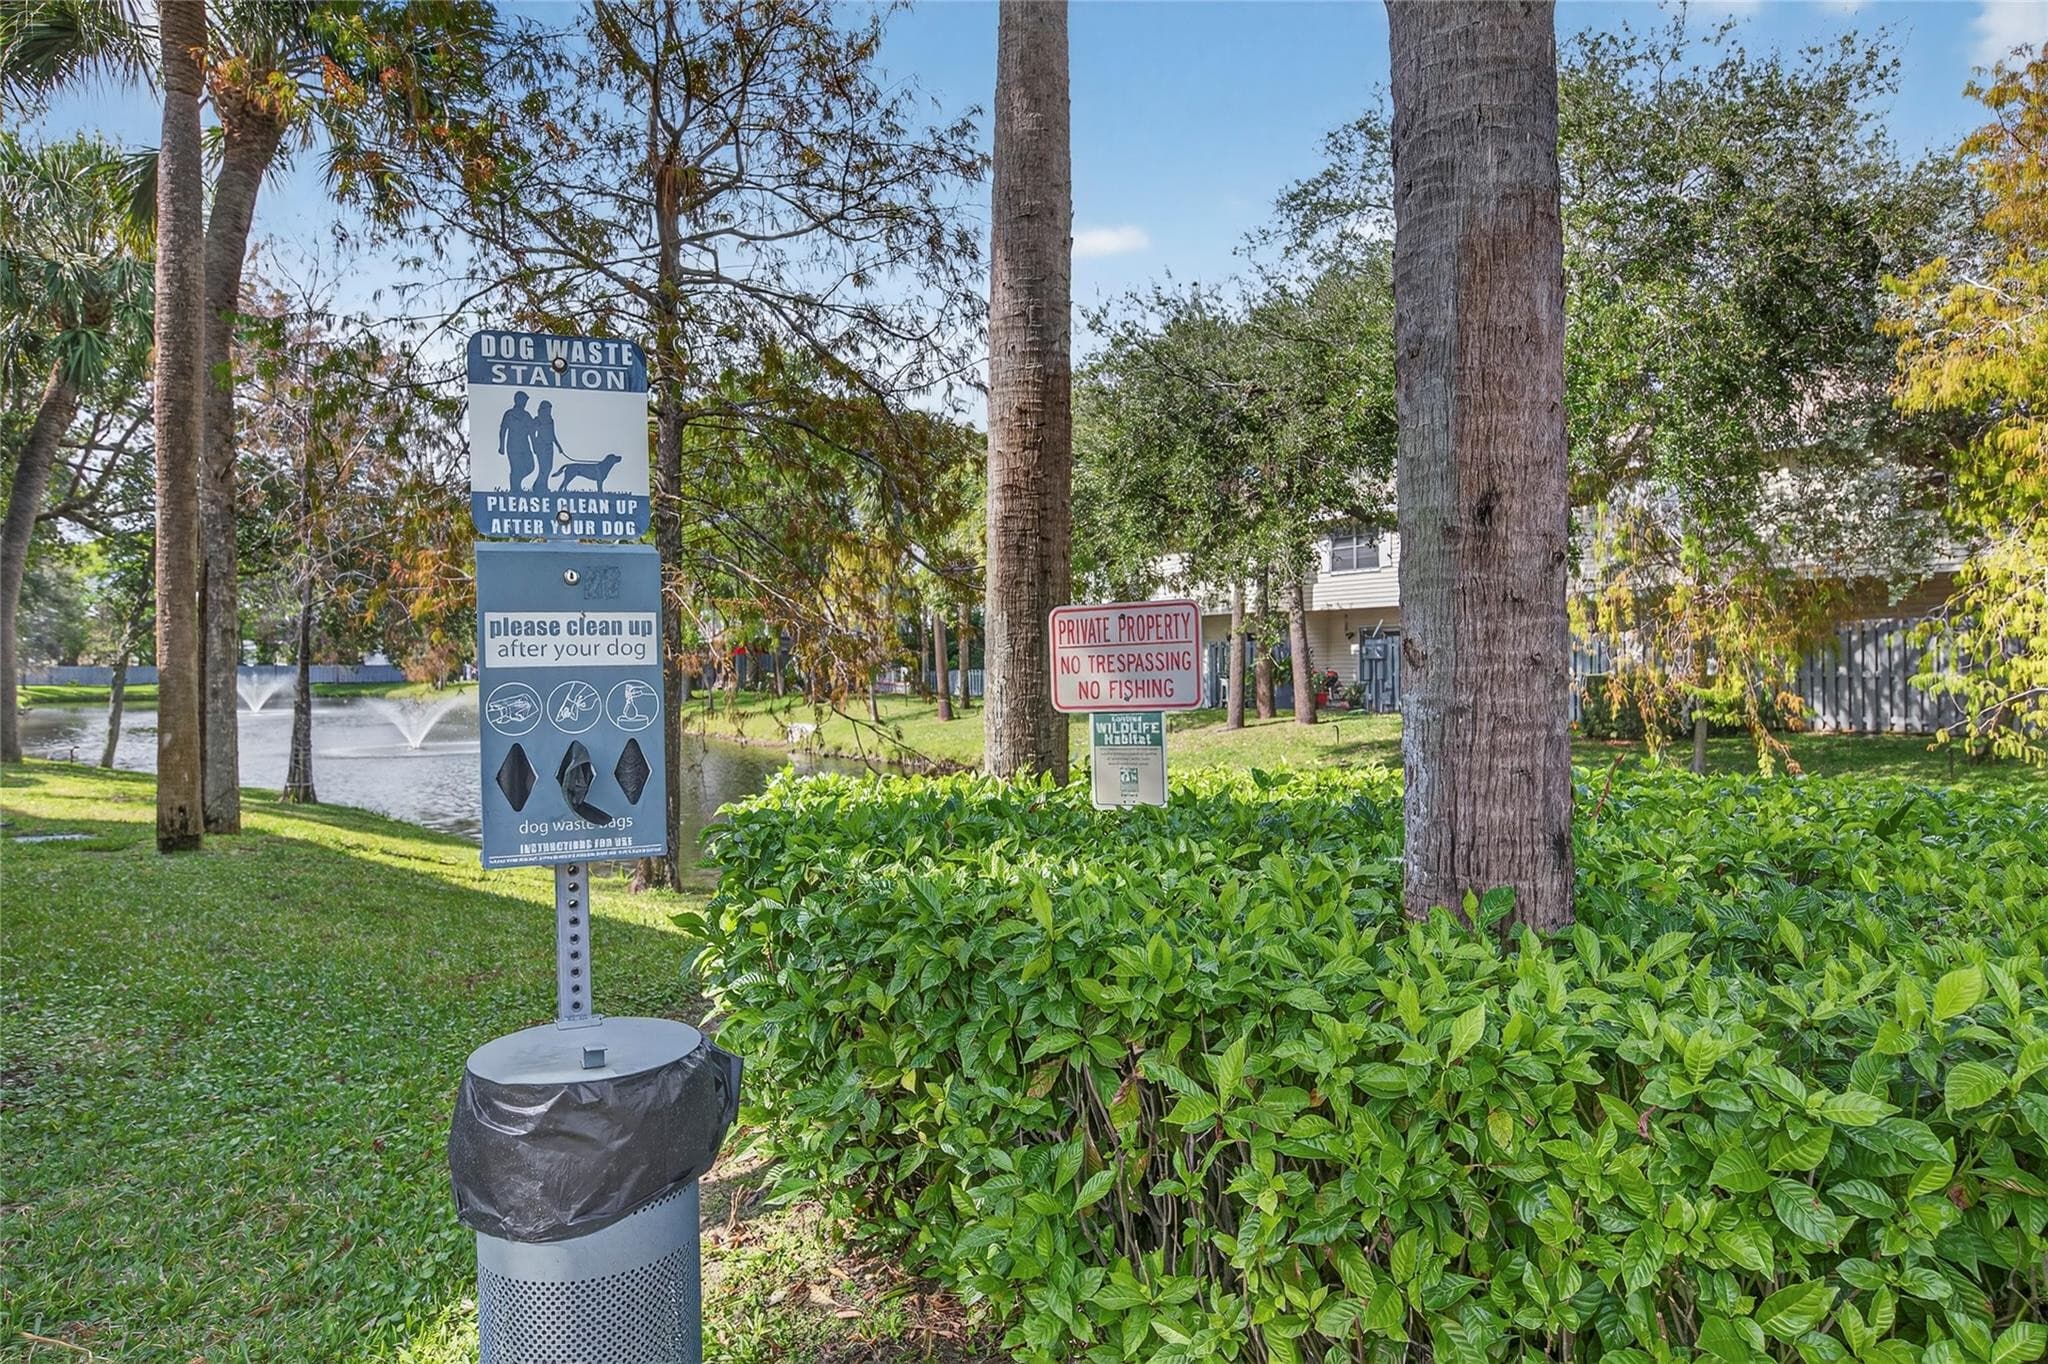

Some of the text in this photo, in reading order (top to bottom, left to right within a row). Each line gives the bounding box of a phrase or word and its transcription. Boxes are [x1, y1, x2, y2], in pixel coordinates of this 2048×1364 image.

[481, 334, 633, 365] DOG WASTE
[491, 364, 625, 390] STATION
[487, 496, 638, 514] PLEASE CLEAN UP
[491, 518, 636, 536] AFTER YOUR DOG
[489, 616, 653, 639] please clean up
[1058, 612, 1191, 645] PRIVATE PROPERTY
[498, 638, 646, 661] after your dog
[1060, 651, 1192, 675] NO TRESPASSING
[1078, 678, 1174, 700] NO FISHING
[1096, 722, 1160, 734] WILDLIFE
[1104, 733, 1151, 745] Habitat
[519, 816, 633, 836] dog waste ags
